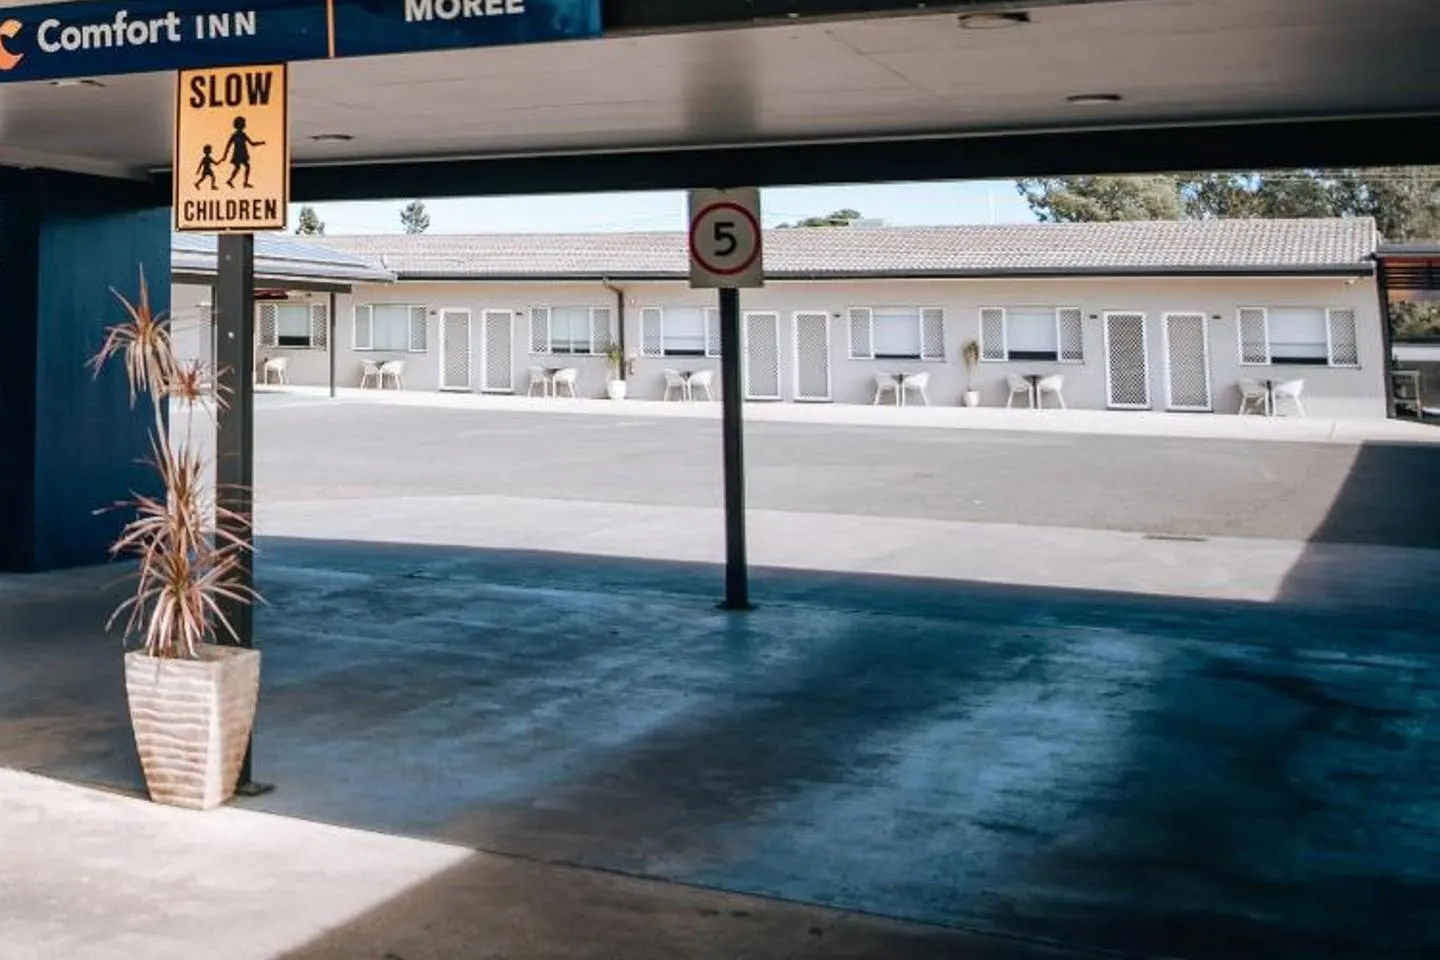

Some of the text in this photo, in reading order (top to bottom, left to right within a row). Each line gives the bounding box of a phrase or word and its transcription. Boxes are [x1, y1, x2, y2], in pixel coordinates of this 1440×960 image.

[37, 10, 181, 53] Comfort
[195, 11, 256, 39] INN
[189, 72, 273, 108] SLOW
[184, 199, 277, 221] CHILDREN
[713, 222, 737, 256] 5
